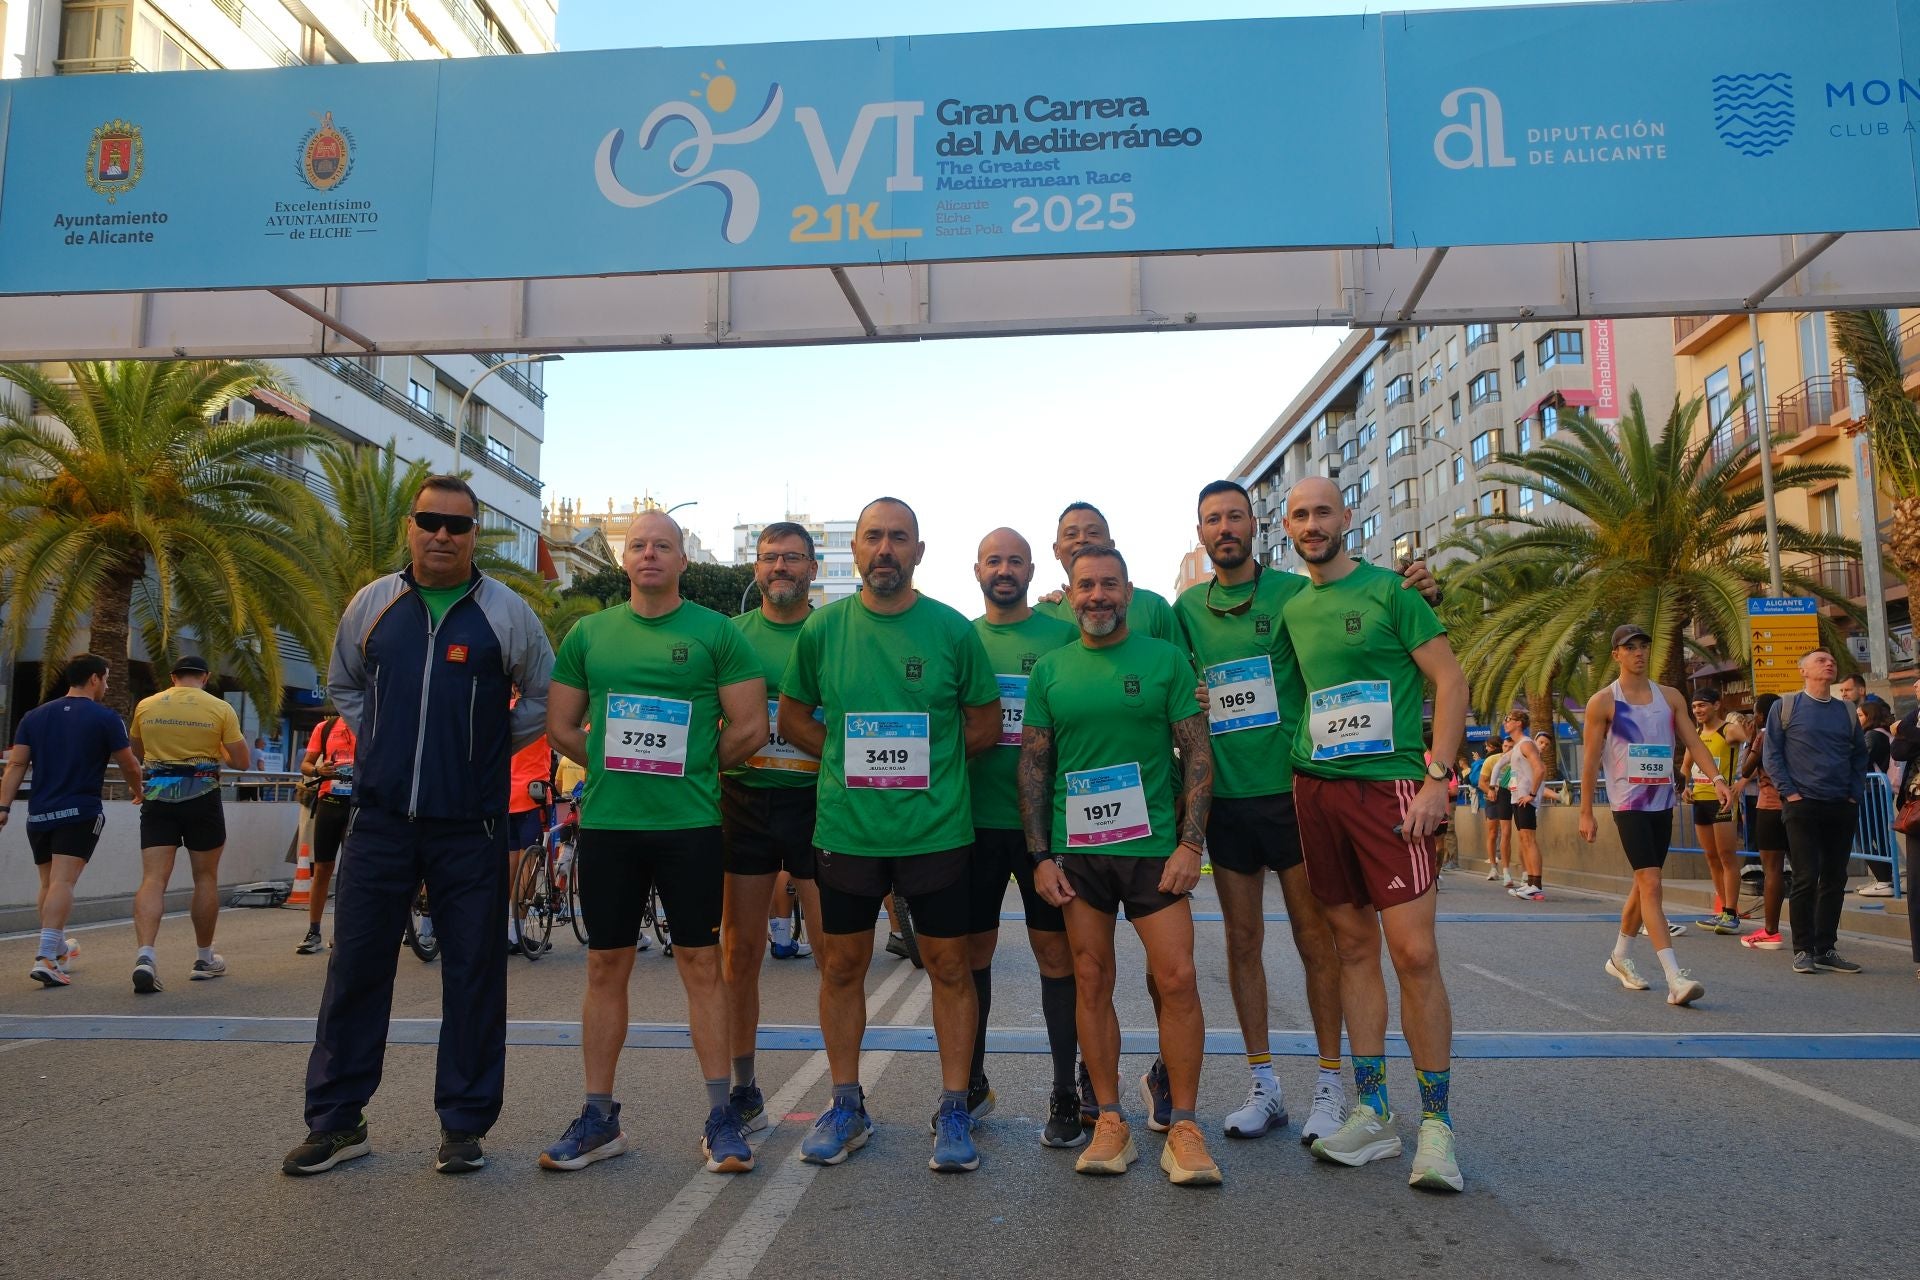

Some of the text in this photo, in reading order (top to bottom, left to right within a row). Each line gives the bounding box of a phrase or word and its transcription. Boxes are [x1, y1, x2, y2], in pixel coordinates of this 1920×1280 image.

[936, 95, 1150, 126] Gran Carrera
[1527, 120, 1666, 143] DIPUTACIÓN
[1829, 122, 1889, 137] CLUB
[794, 101, 924, 196] VI
[936, 123, 1203, 157] del Mediterráneo
[1529, 145, 1668, 165] DE ALICANTE
[936, 158, 1061, 175] The Greatest
[935, 171, 1132, 191] Mediterranean Race
[275, 199, 371, 213] Excelentísimo
[936, 199, 990, 211] Alicante
[1011, 192, 1136, 234] 2025
[53, 211, 168, 230] Ayuntamiento
[265, 212, 378, 226] AYUNTAMIENTO
[790, 202, 923, 243] 21K
[936, 213, 971, 224] Elche
[64, 229, 154, 245] de Alicante
[289, 227, 352, 239] de ELCHE
[936, 224, 1003, 237] Santa Pola
[1219, 691, 1256, 709] 1969
[866, 721, 878, 732] VI
[1328, 714, 1372, 734] 2742
[621, 730, 667, 749] 3783
[865, 749, 909, 764] 3419
[1640, 763, 1664, 772] 3638
[1078, 779, 1091, 789] VI
[1083, 802, 1122, 821] 1917
